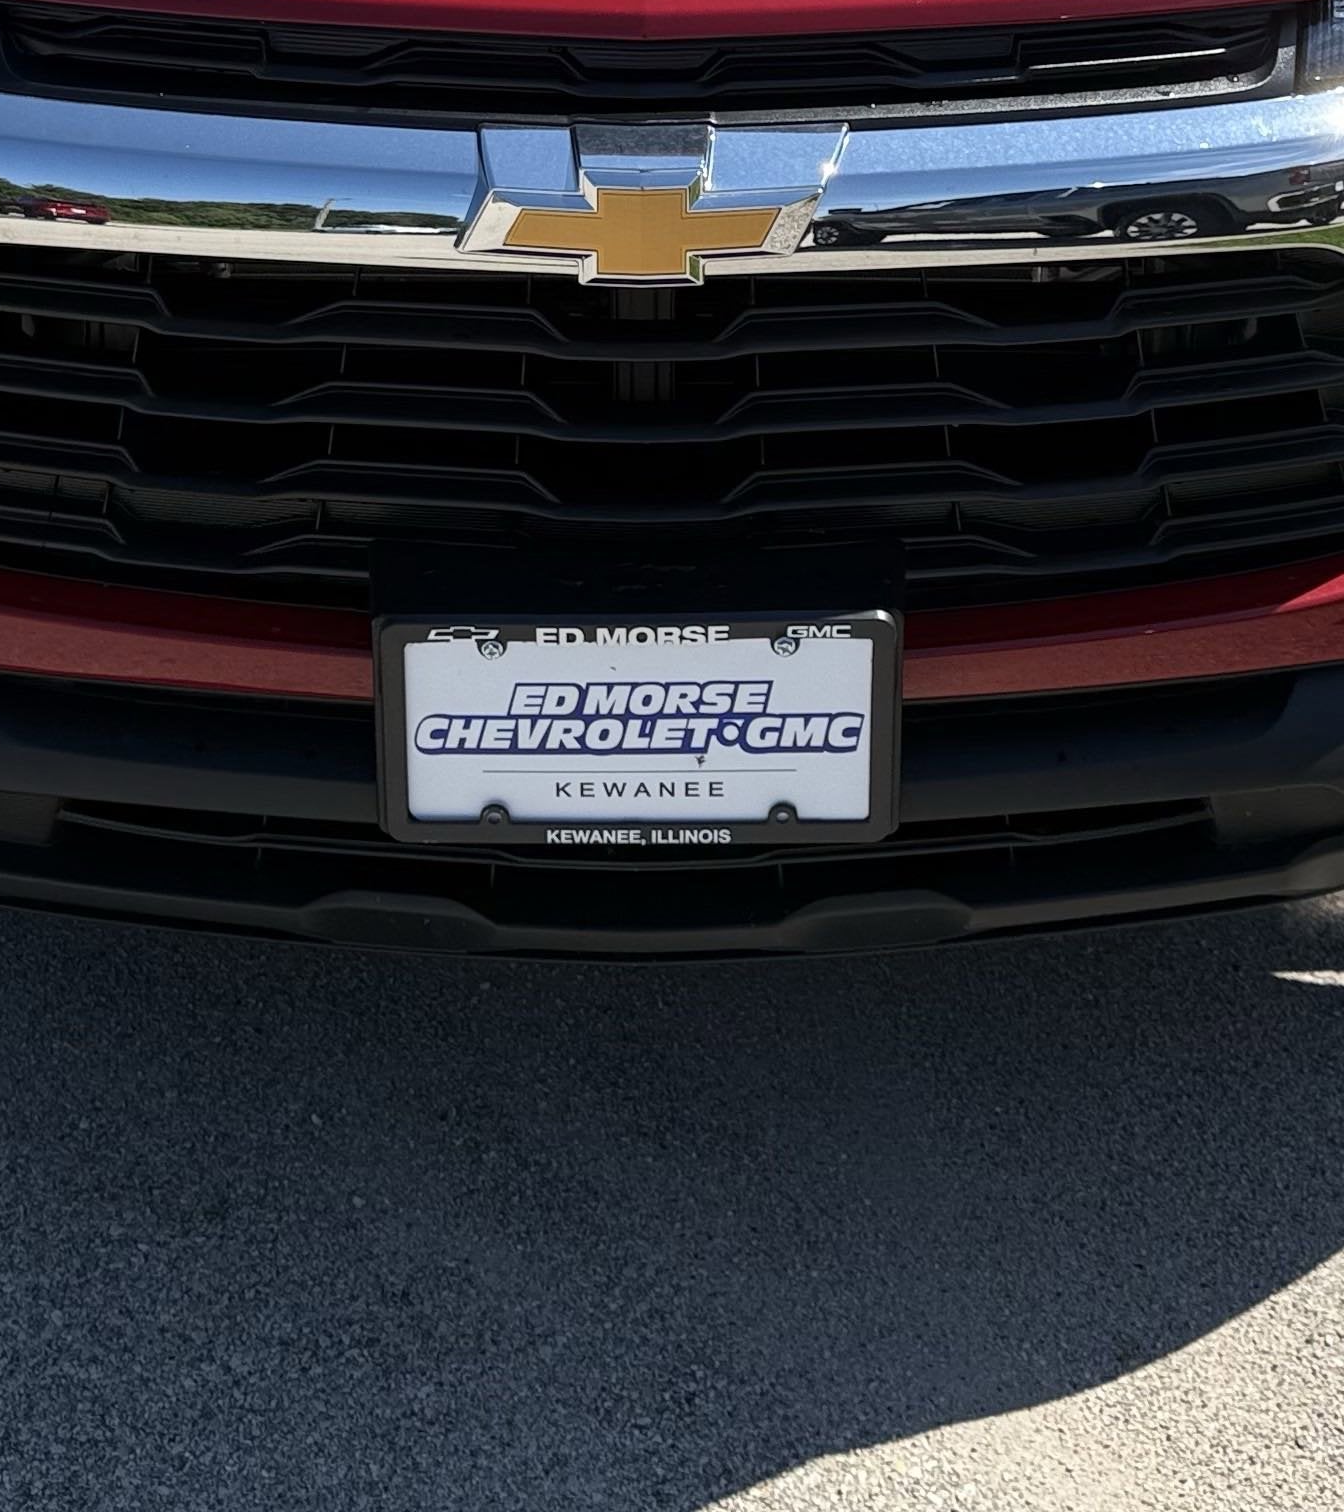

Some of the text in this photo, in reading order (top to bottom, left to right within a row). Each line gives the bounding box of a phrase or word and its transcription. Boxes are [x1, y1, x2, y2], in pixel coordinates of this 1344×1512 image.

[535, 625, 730, 646] ED MORSE
[786, 625, 852, 639] GMC
[509, 681, 771, 716] ED MORSE
[555, 781, 725, 798] KEWANEE
[546, 828, 732, 846] KEWANEE, ILLINOIS
